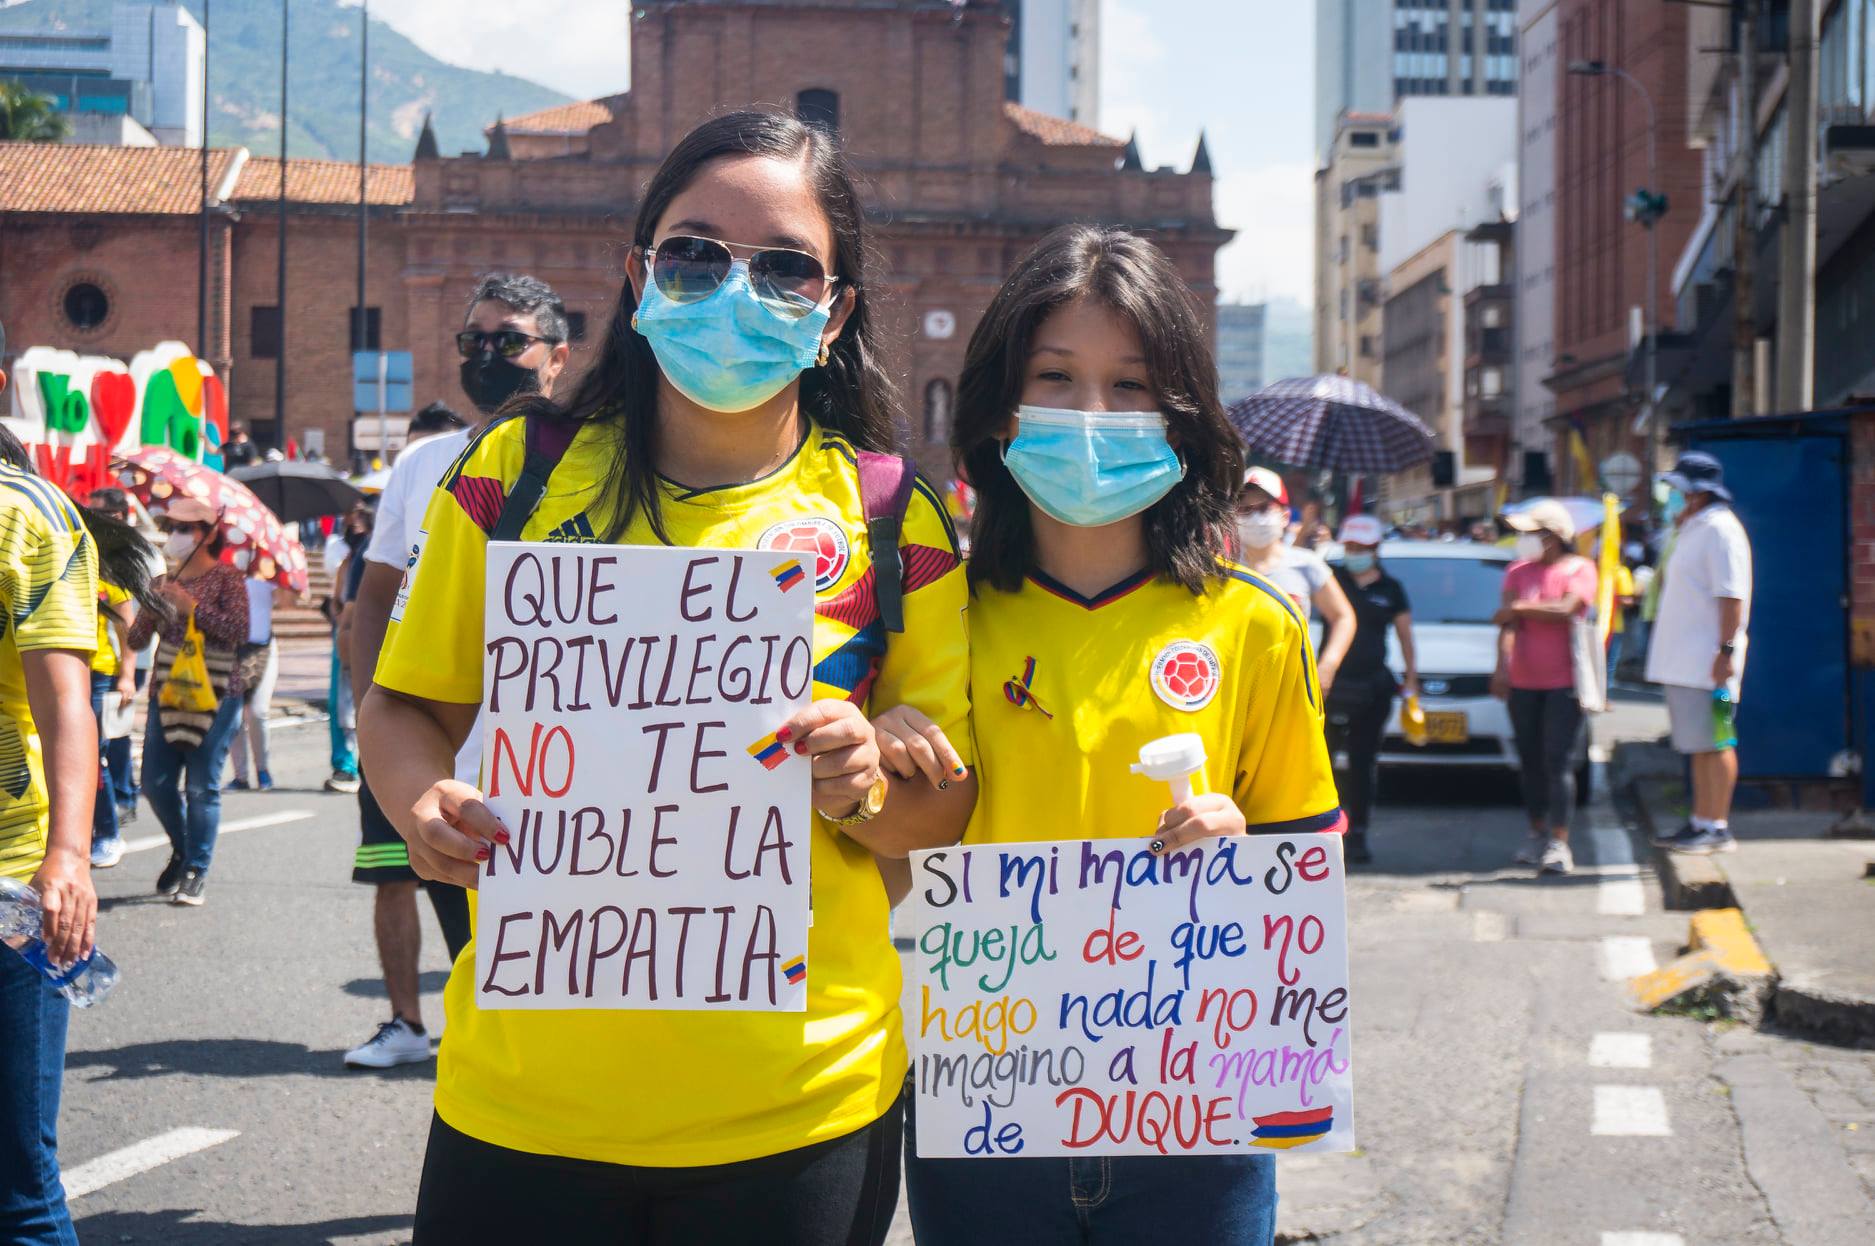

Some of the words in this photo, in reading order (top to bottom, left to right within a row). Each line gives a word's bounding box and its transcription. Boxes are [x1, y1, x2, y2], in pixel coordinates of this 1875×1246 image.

[36, 371, 88, 433] Yo
[504, 552, 618, 628] QUE
[680, 555, 758, 623] EL
[486, 633, 812, 713] PRIVILEGIO
[489, 722, 575, 798] NO
[642, 721, 729, 793] TE
[486, 804, 680, 877] NUBLE
[724, 805, 794, 885] LA
[1000, 846, 1059, 924] mi
[1078, 837, 1253, 924] mamá
[482, 903, 781, 1005] EMPATIA
[920, 920, 1057, 993] queja
[1082, 906, 1145, 965] de
[1170, 921, 1247, 990] que
[1263, 914, 1325, 985] no
[921, 984, 1038, 1056] hago
[1059, 959, 1186, 1043] nada
[1196, 986, 1258, 1050] no
[1270, 985, 1349, 1047] me
[1108, 1045, 1138, 1085] a
[1160, 1027, 1198, 1085] la
[1208, 1027, 1350, 1120] mamá
[963, 1101, 1025, 1155] de
[1055, 1086, 1241, 1155] DUQUE.
